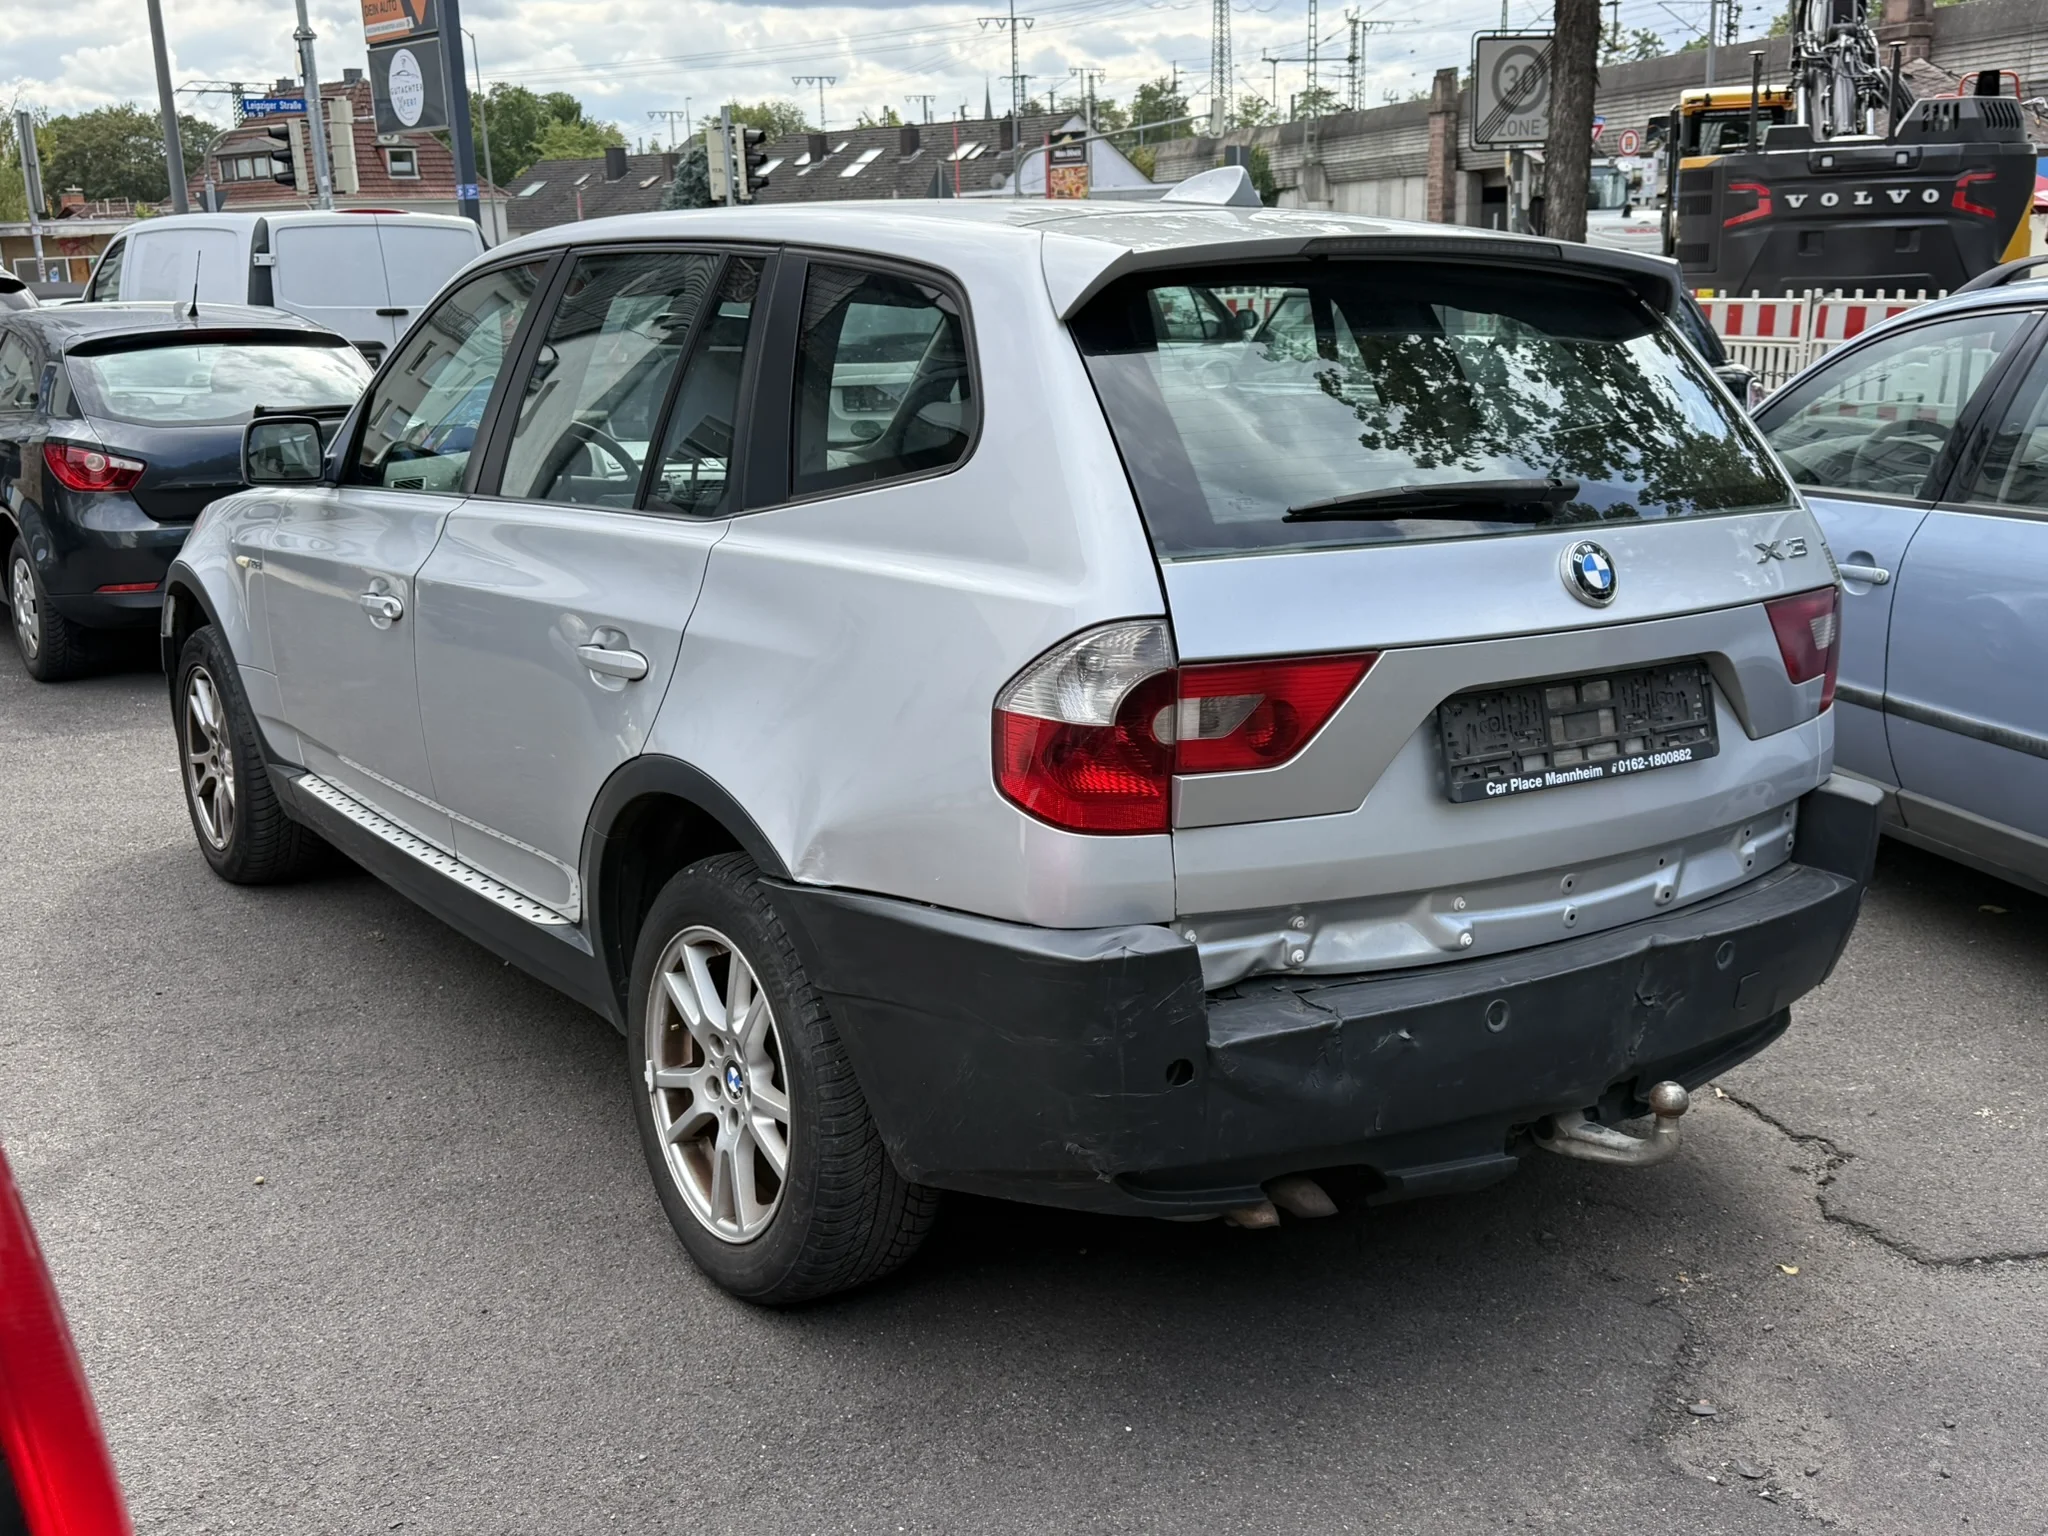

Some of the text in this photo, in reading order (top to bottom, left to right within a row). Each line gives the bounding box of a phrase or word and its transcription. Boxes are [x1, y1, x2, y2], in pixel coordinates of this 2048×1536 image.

[380, 0, 398, 12] AUTO
[1504, 64, 1537, 96] 30
[246, 100, 302, 112] Leipziger Straße
[1497, 120, 1540, 137] ZONE
[1784, 188, 1940, 208] VOLVO
[1573, 544, 1608, 563] BMW
[1754, 536, 1808, 565] X3
[1486, 747, 1693, 796] Car Place Mannheim 0162-1800882
